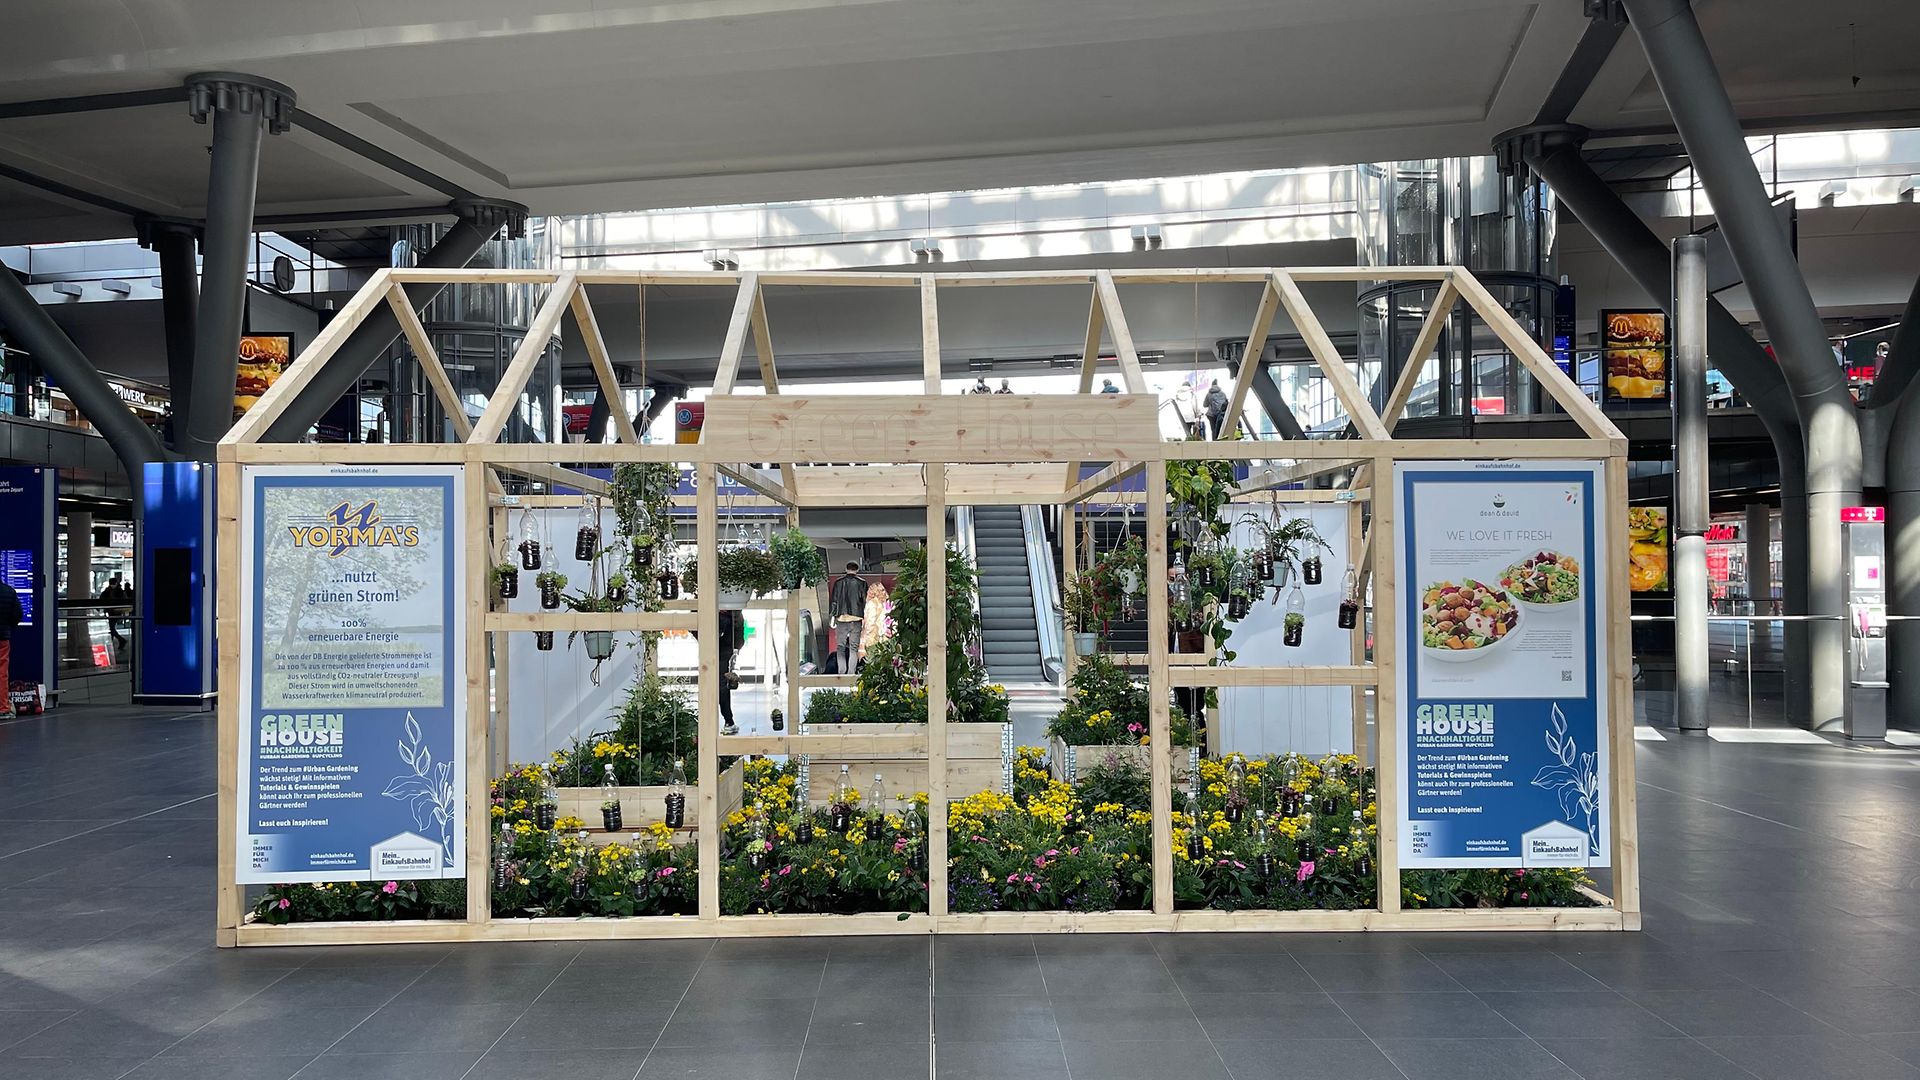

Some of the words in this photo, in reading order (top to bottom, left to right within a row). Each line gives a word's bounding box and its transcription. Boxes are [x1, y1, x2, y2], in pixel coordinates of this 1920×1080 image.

[288, 526, 419, 547] YORMA'S
[1447, 531, 1465, 541] WE
[1469, 531, 1498, 541] LOVE
[1503, 531, 1513, 541] IT
[1516, 530, 1553, 541] FRESH
[332, 571, 377, 583] ...nutzt
[308, 591, 353, 604] grünen
[357, 590, 399, 602] Strom!
[341, 619, 366, 627] 100%
[308, 632, 363, 641] erneuerbare
[365, 631, 399, 643] Energie
[323, 653, 348, 661] Energie
[382, 653, 422, 661] Strommenge
[300, 672, 336, 680] vollständig
[389, 692, 424, 700] produziert.
[1417, 704, 1494, 721] GREEN
[260, 714, 343, 732] GREEN
[1417, 719, 1494, 734] HOUSE
[260, 730, 343, 746] HOUSE
[260, 746, 342, 754] #NACHHALTIGKEIT
[1479, 754, 1509, 762] Gardening
[326, 765, 358, 773] Gardening
[294, 783, 340, 791] Gewinnspielen
[1471, 780, 1513, 788] professionellen
[317, 791, 362, 800] professionellen
[1449, 806, 1482, 814] inspirieren!
[292, 819, 328, 827] inspirieren!
